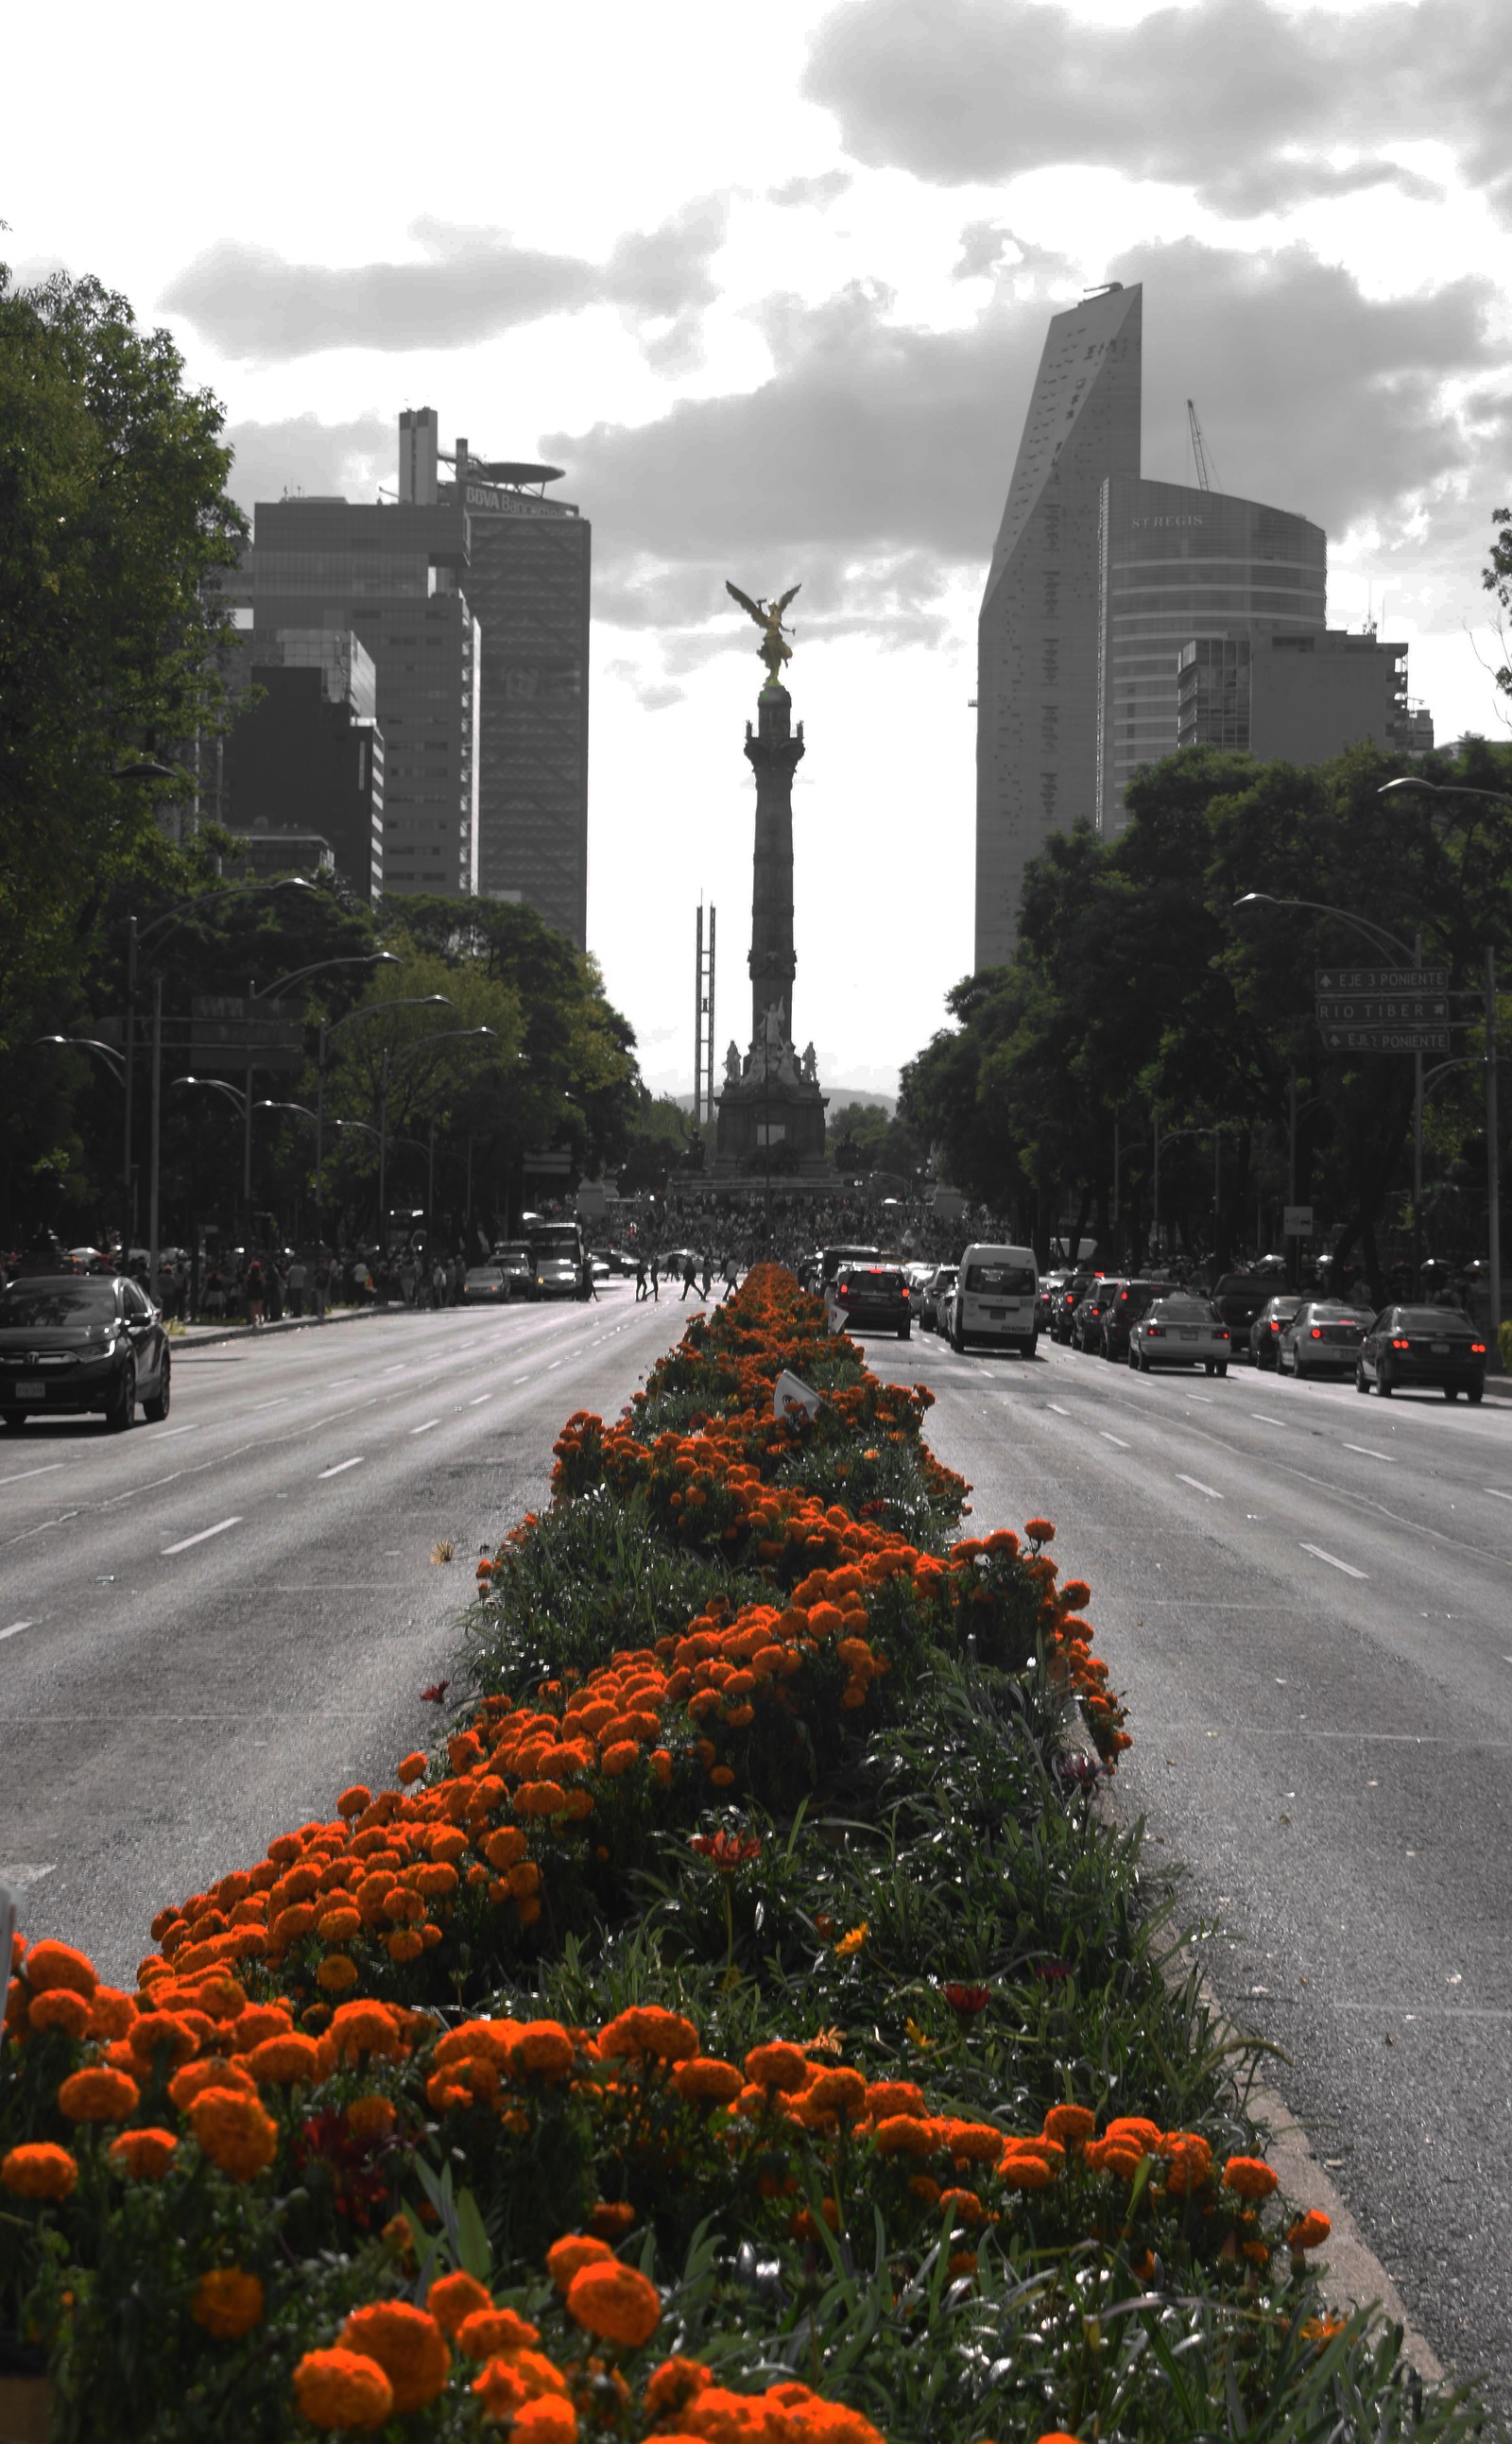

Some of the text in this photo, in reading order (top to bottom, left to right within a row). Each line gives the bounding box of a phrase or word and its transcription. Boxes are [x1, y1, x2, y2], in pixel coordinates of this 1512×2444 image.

[466, 485, 499, 509] BBVA
[1154, 515, 1203, 527] REGIS
[1339, 972, 1444, 988] EJE 3 PONIENTE
[1319, 1004, 1423, 1019] RIO TIBER
[1348, 1032, 1369, 1046] EJE
[1382, 1034, 1446, 1049] PONIENTE
